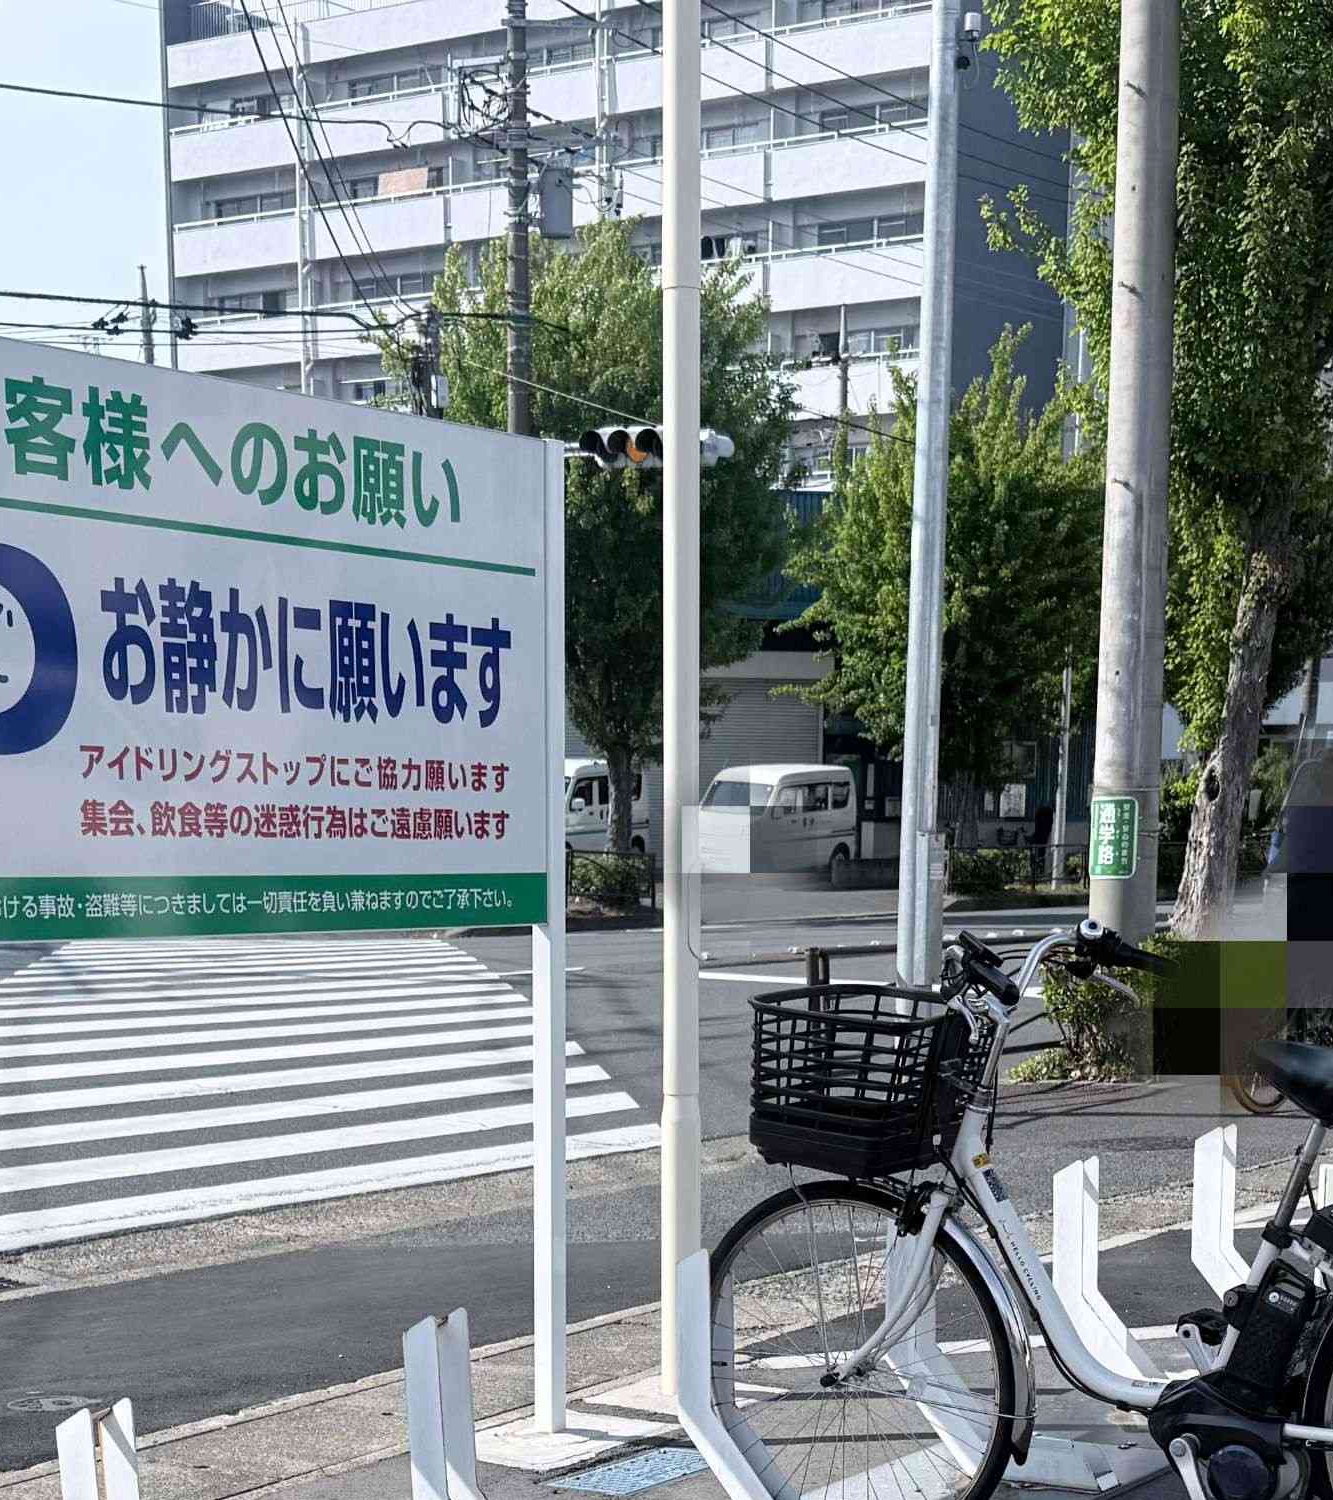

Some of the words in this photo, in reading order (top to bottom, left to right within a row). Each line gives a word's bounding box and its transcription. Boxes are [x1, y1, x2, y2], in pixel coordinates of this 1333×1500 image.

[99, 576, 512, 728] お静かに願います
[79, 744, 510, 793] アイドリングストップにご協力願います
[79, 799, 510, 841] 集会、飲食等の迷惑行為はご遠慮願います
[1098, 802, 1116, 865] 通学路
